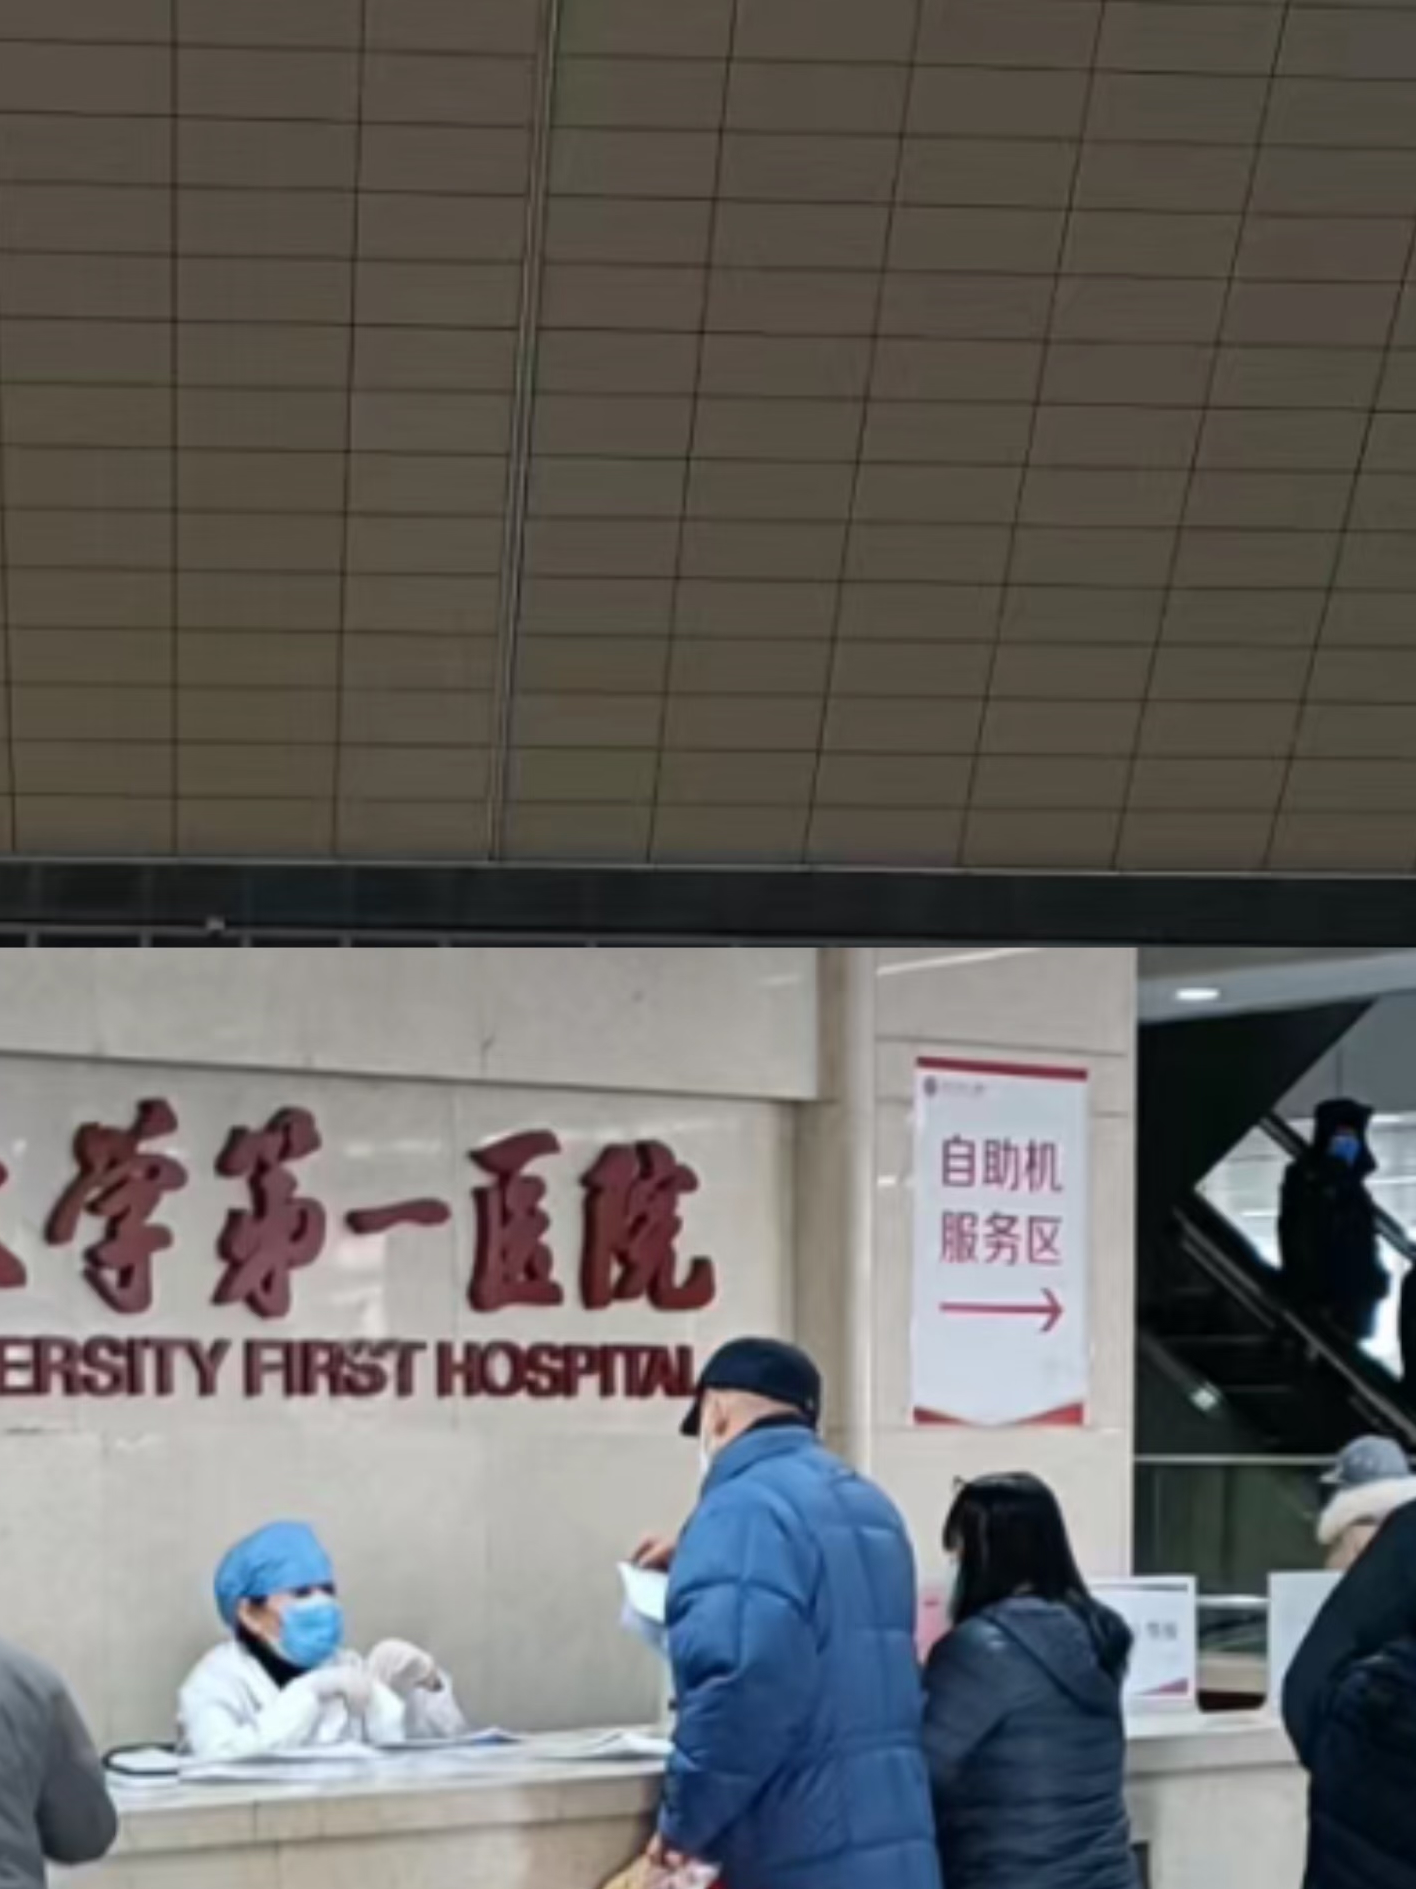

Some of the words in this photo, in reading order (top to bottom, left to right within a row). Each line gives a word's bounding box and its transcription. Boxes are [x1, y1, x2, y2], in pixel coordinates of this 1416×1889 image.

[941, 1133, 1063, 1193] 自助机
[941, 1209, 1063, 1267] 服务区
[243, 1339, 427, 1399] FIRST
[435, 1343, 695, 1400] HOSPITAL
